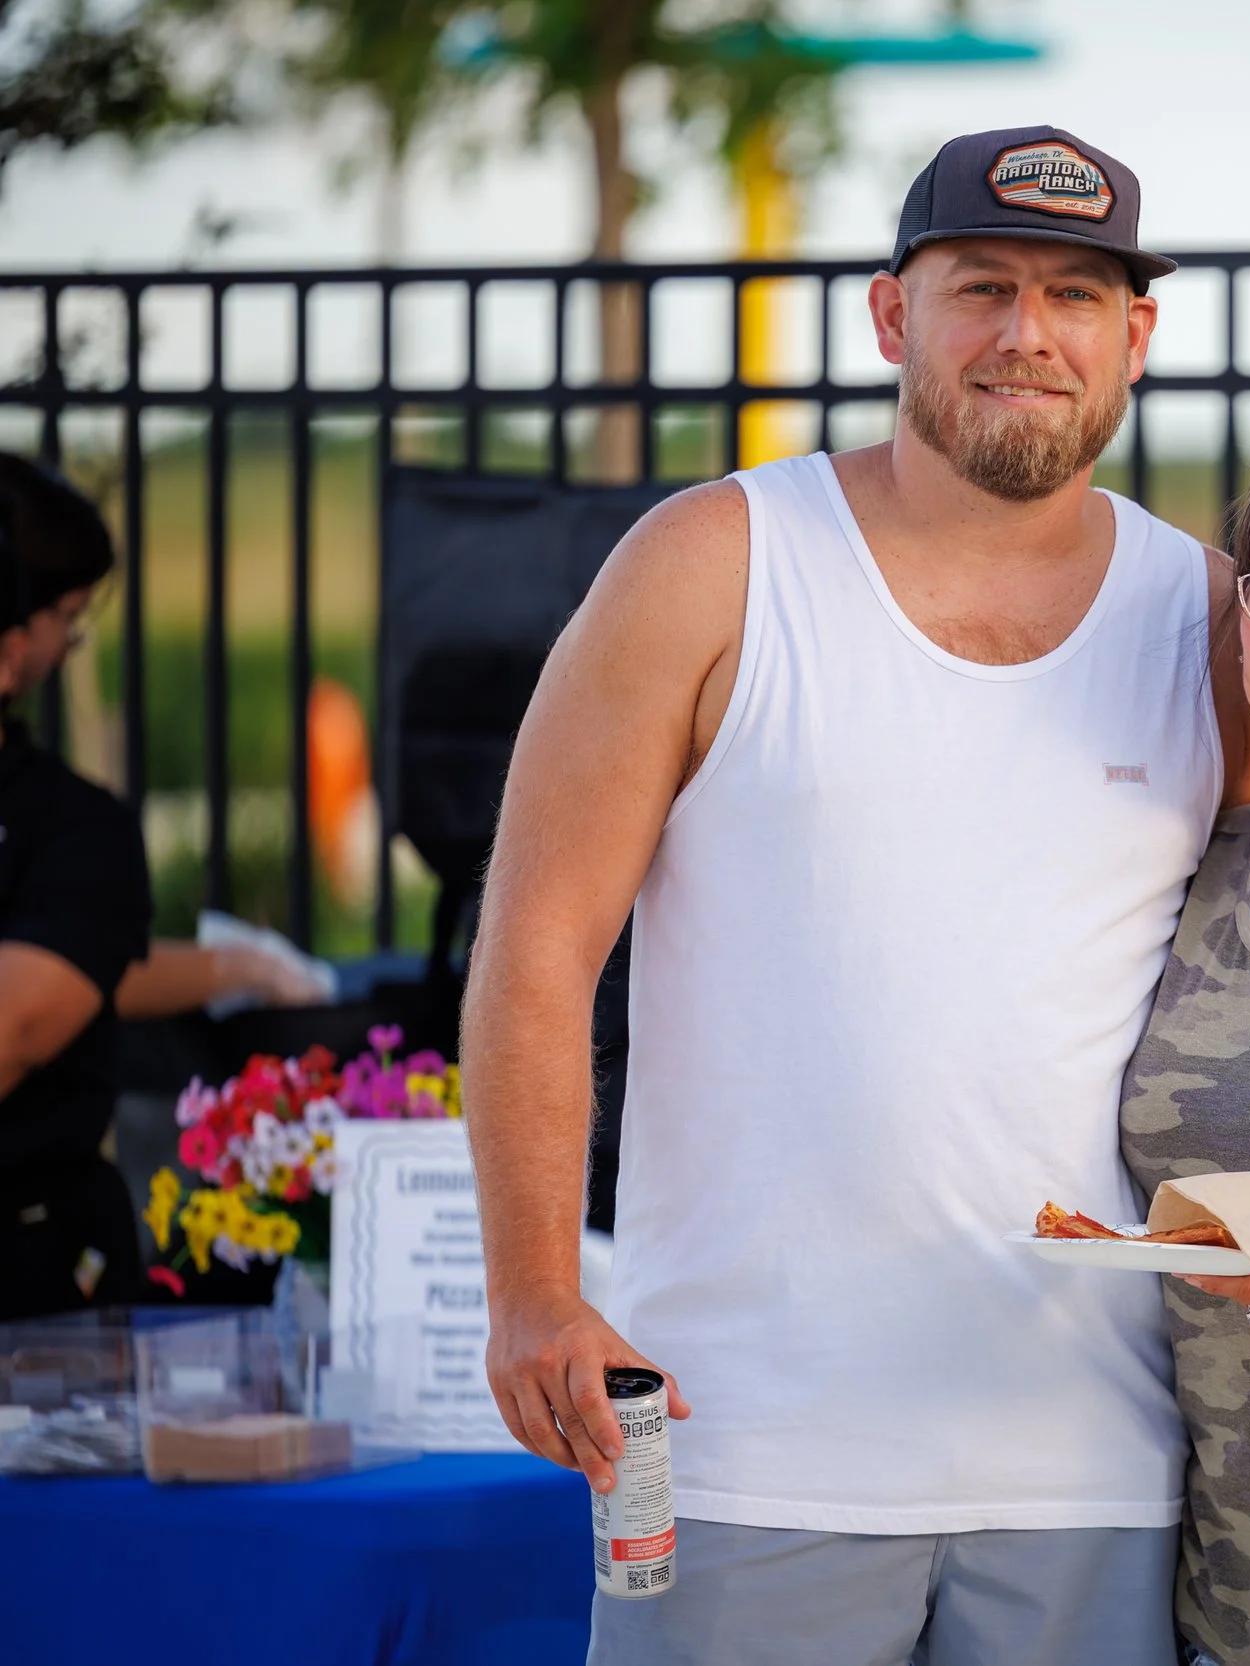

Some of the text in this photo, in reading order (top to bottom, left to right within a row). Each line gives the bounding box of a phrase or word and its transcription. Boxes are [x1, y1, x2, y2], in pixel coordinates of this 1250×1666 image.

[1052, 150, 1064, 158] TX
[996, 161, 1082, 181] RADIATOR
[1039, 174, 1096, 192] RANCH
[619, 1406, 659, 1420] CELSIUS
